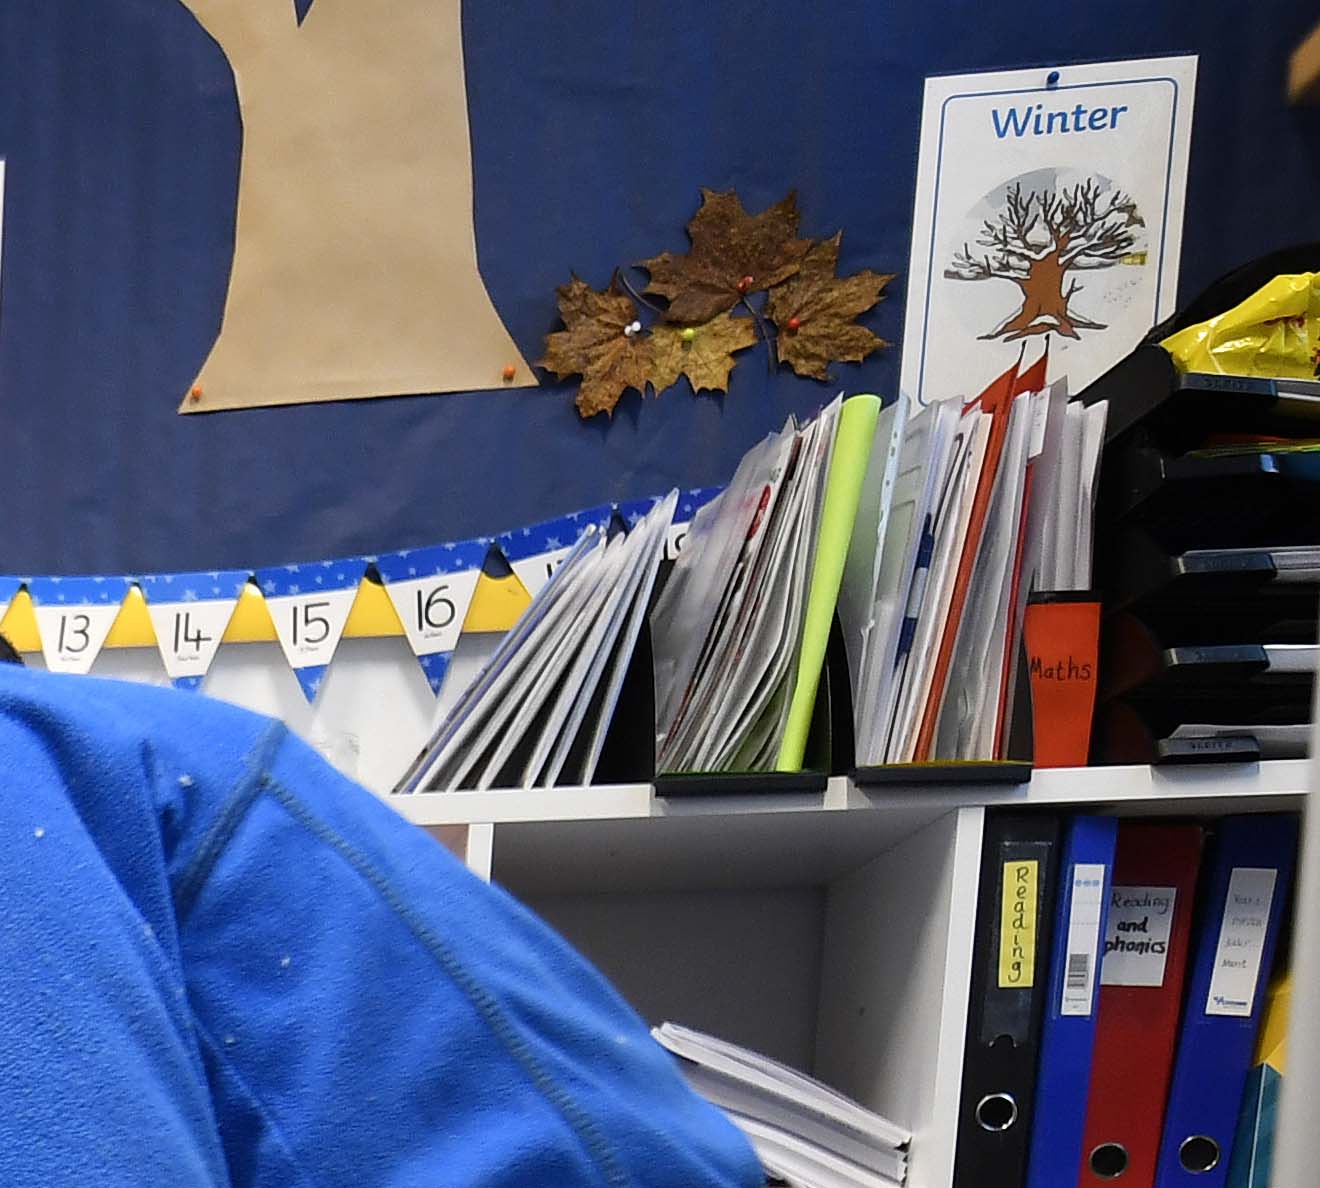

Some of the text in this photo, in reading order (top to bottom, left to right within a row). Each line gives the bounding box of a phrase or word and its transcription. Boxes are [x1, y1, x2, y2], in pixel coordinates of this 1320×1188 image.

[991, 103, 1128, 139] Winter
[291, 602, 331, 645] 15
[415, 584, 457, 633] 16
[57, 613, 90, 653] 13
[173, 611, 212, 653] 14
[1030, 656, 1091, 681] Maths
[1111, 892, 1169, 916] Reading
[1008, 866, 1029, 982] Reading
[1117, 916, 1148, 933] and
[1104, 936, 1166, 960] phonics
